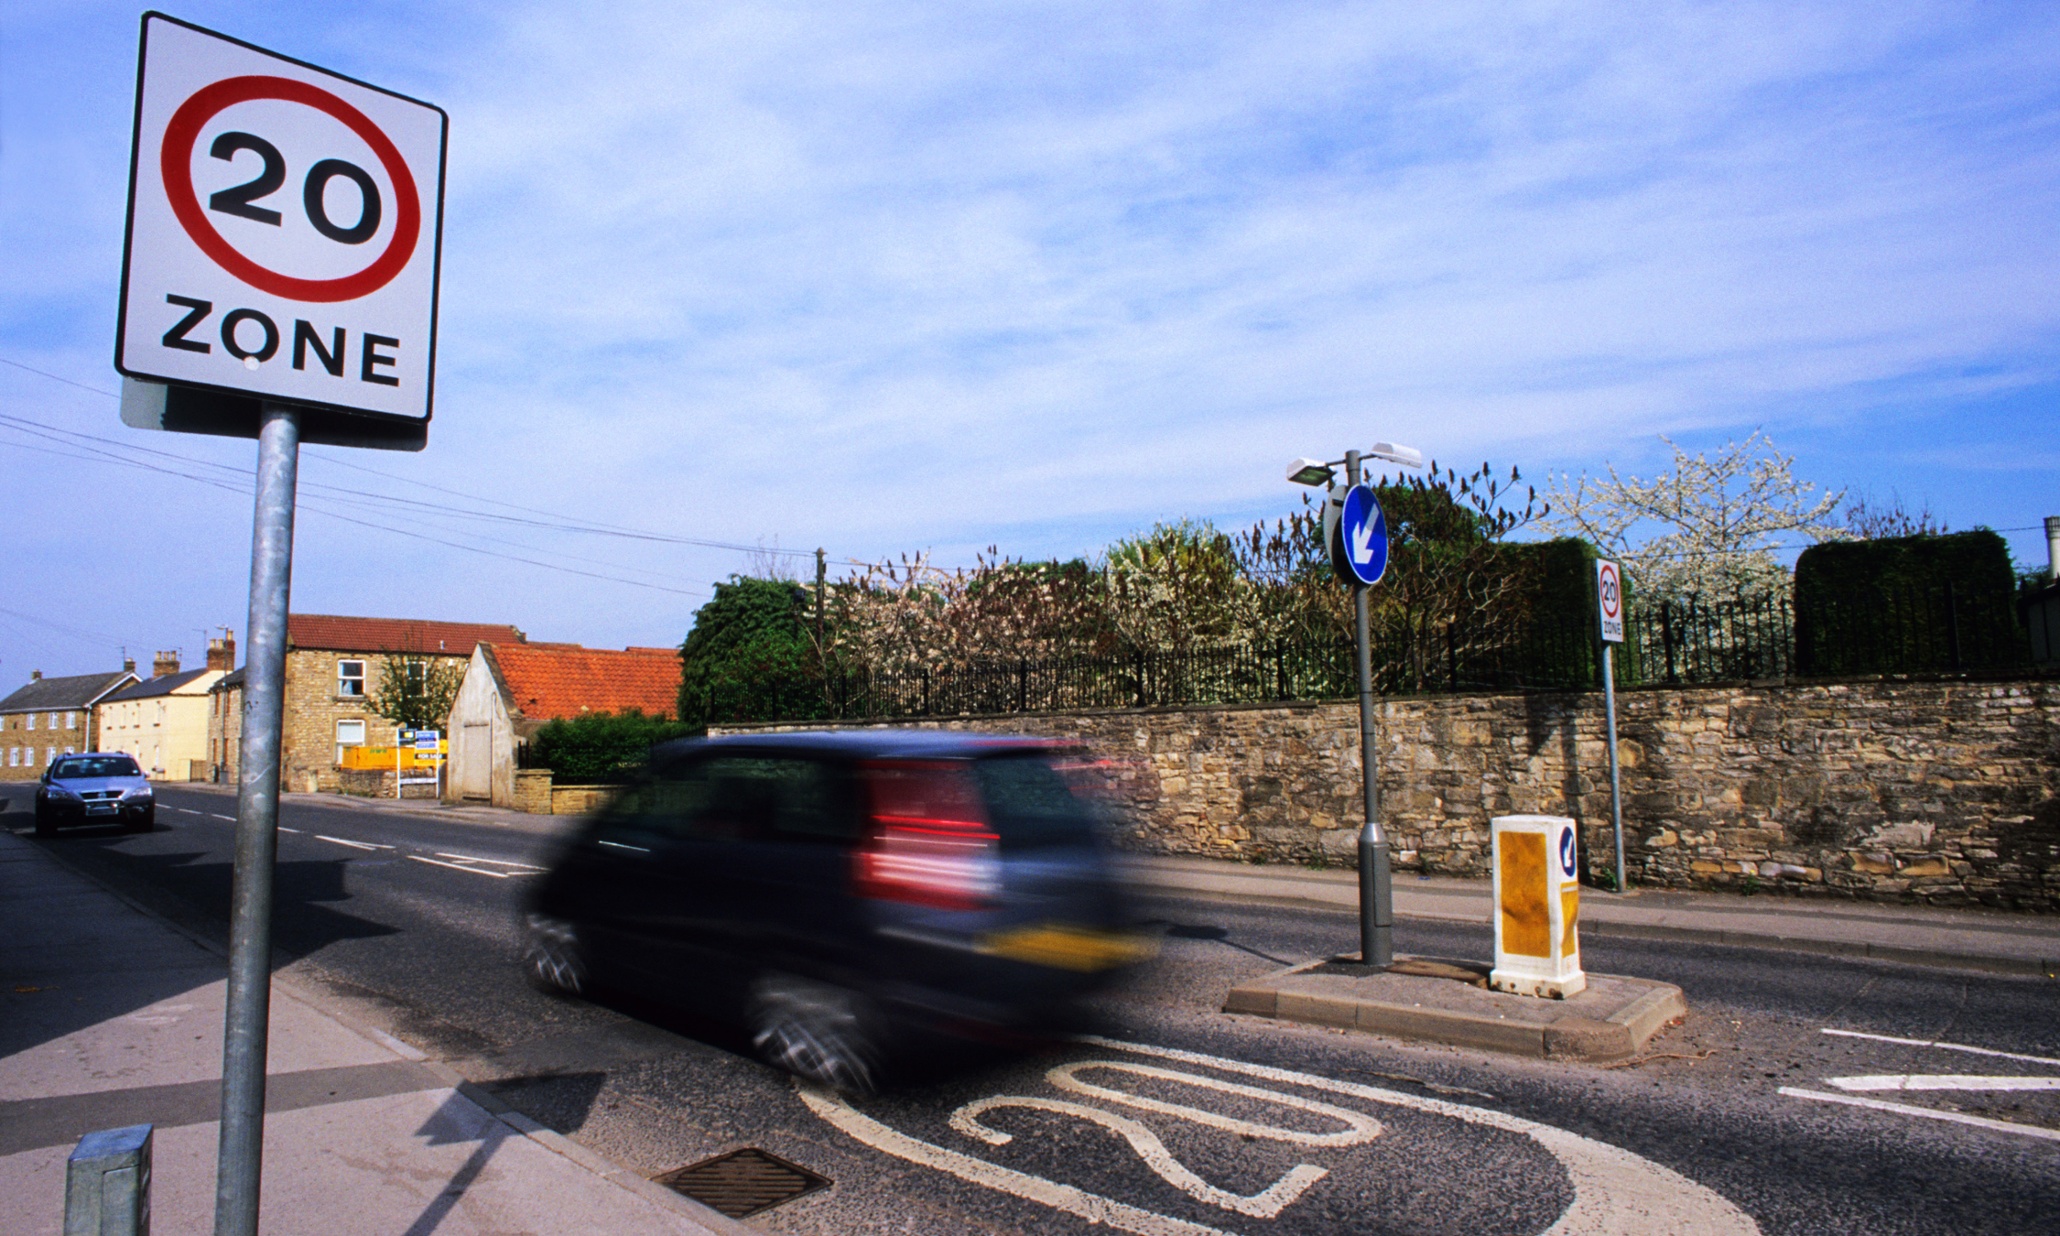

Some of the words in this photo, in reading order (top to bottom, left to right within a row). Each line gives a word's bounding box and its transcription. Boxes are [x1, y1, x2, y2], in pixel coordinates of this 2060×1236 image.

[209, 131, 382, 245] 20
[162, 293, 400, 387] ZONE
[1603, 580, 1616, 602] 20
[1604, 621, 1621, 635] ZONE
[949, 1060, 1383, 1219] 20
